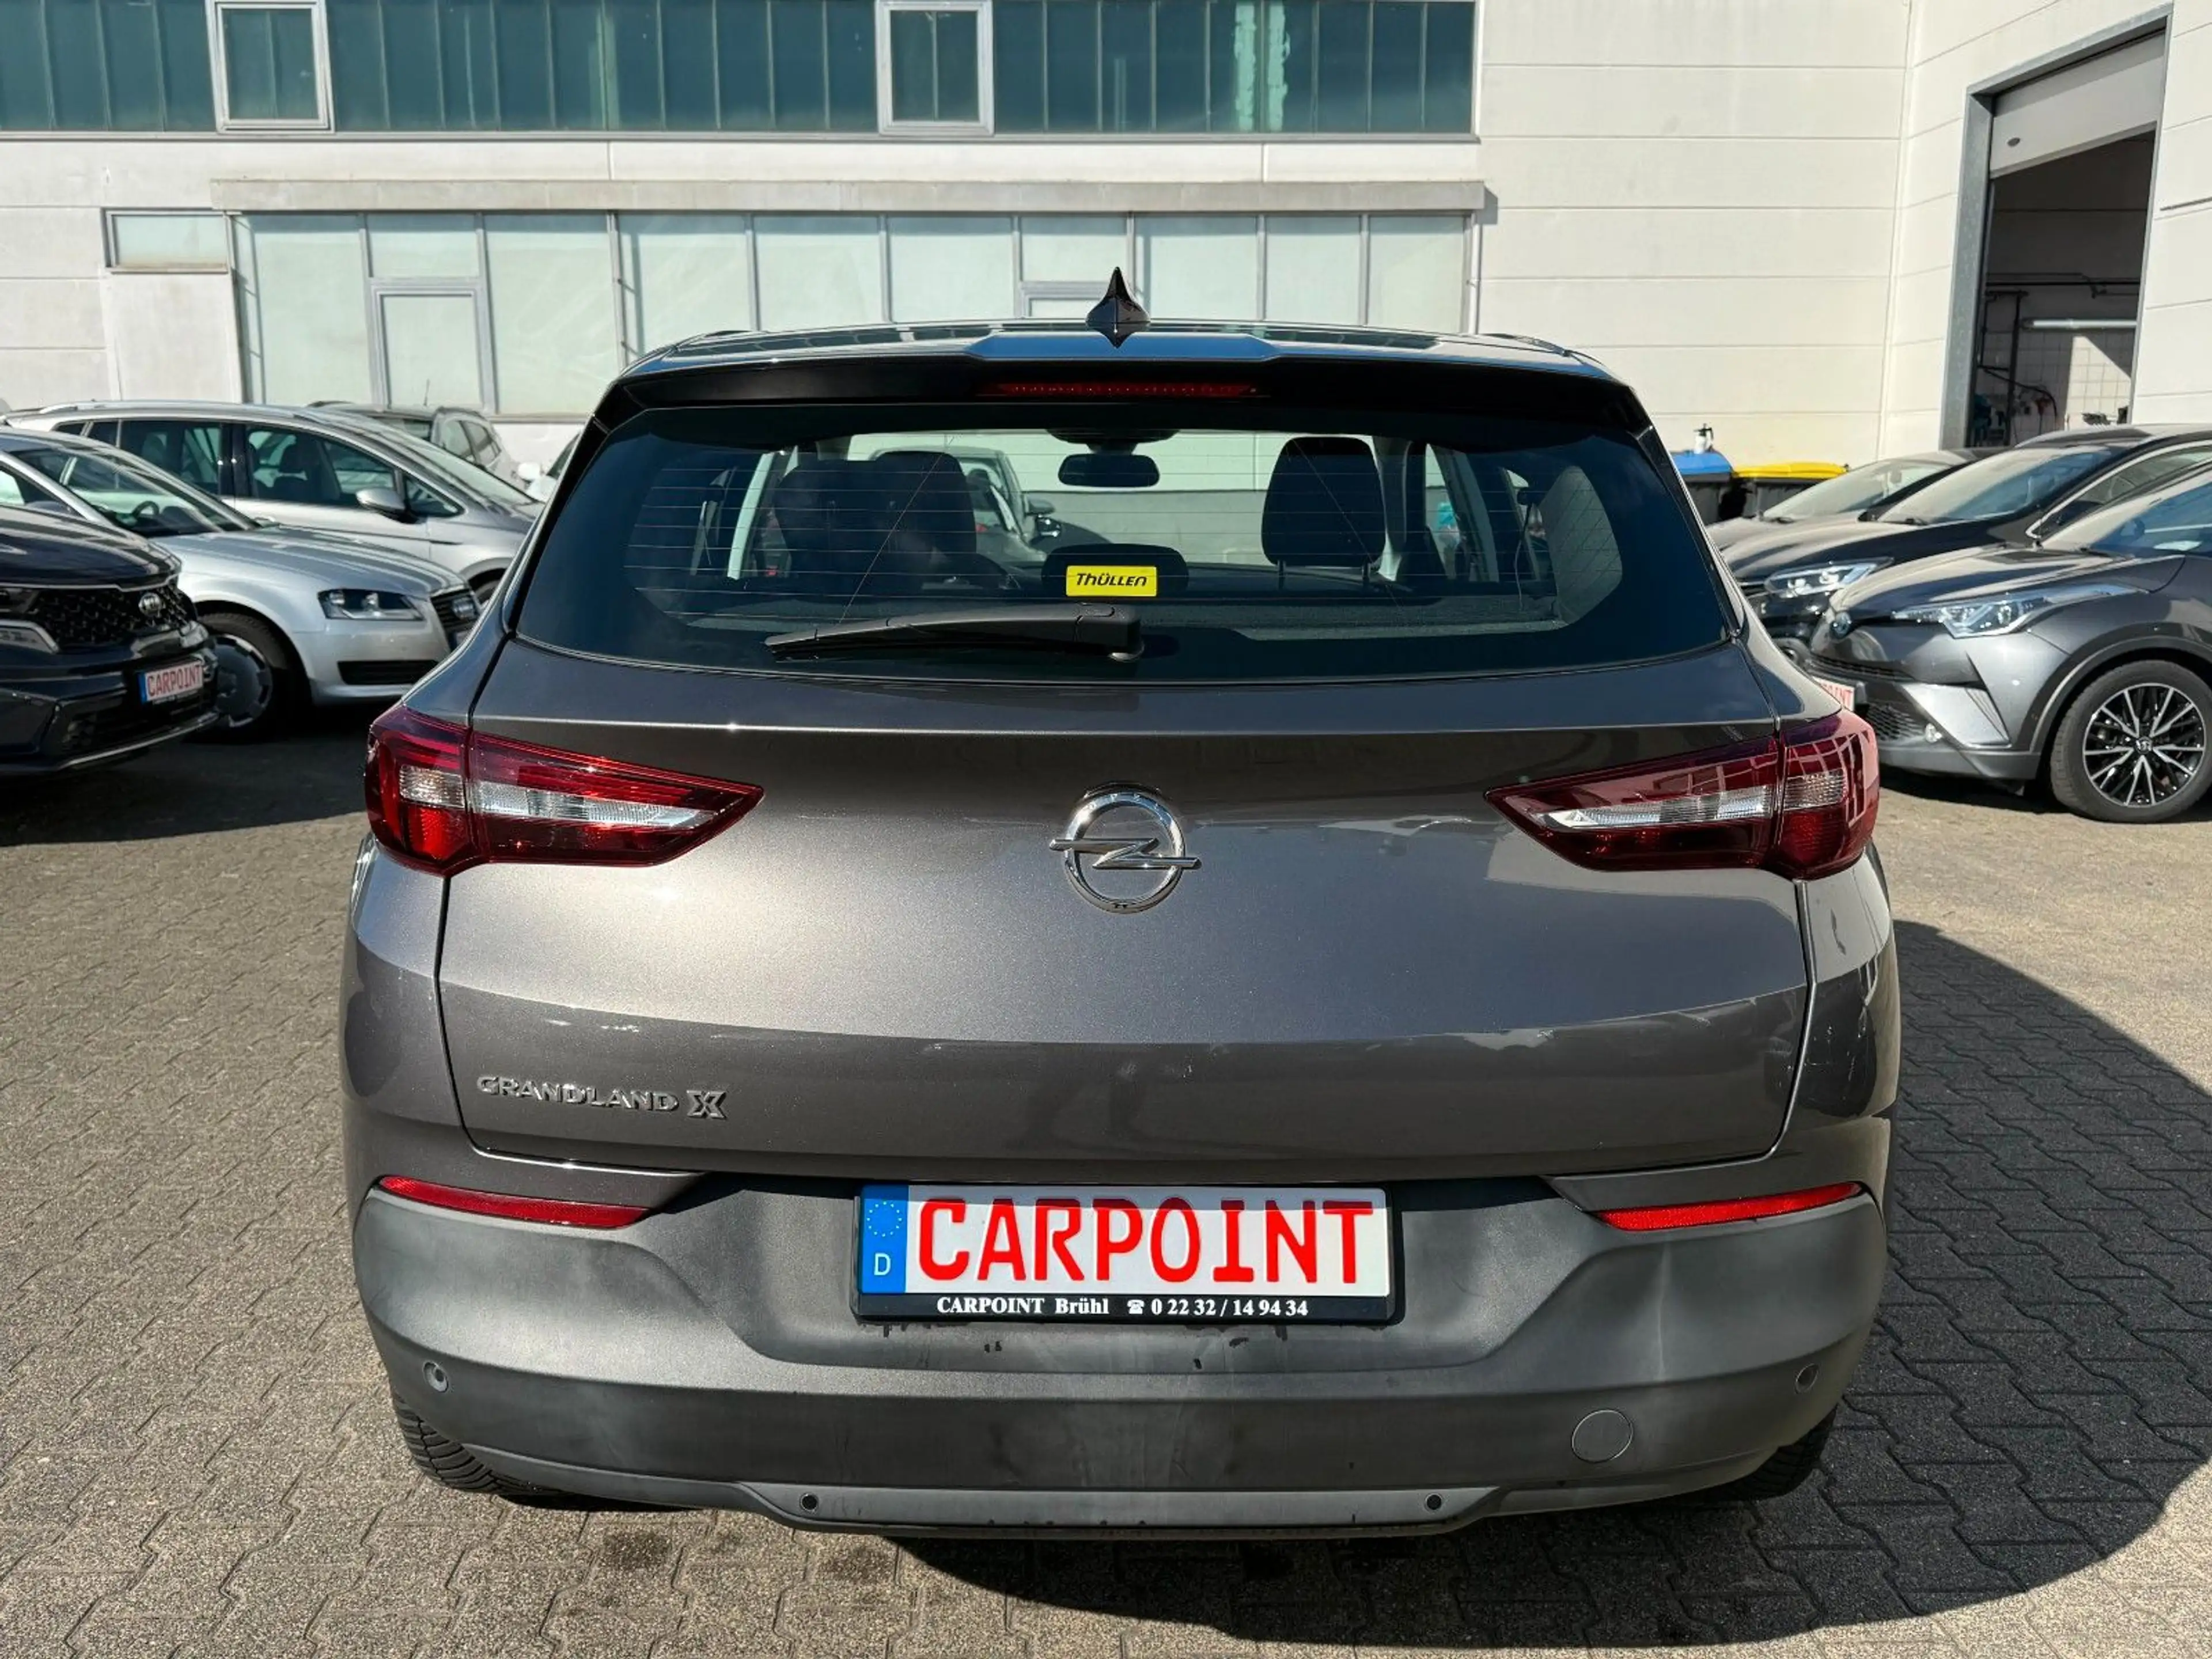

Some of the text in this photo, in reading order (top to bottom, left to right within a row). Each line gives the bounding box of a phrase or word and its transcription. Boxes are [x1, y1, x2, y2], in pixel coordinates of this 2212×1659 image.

[147, 664, 200, 696] CARPOINT
[477, 1075, 728, 1119] GRANDLAND X
[874, 1197, 1374, 1284] D CARPOINT
[937, 1296, 1046, 1314] CARPOINT
[1055, 1297, 1109, 1315] Brühl
[1151, 1298, 1162, 1315] 0
[1167, 1298, 1190, 1315] 22
[1193, 1298, 1217, 1316] 32
[1233, 1298, 1255, 1316] 14
[1258, 1299, 1282, 1316] 94
[1285, 1299, 1309, 1316] 34
